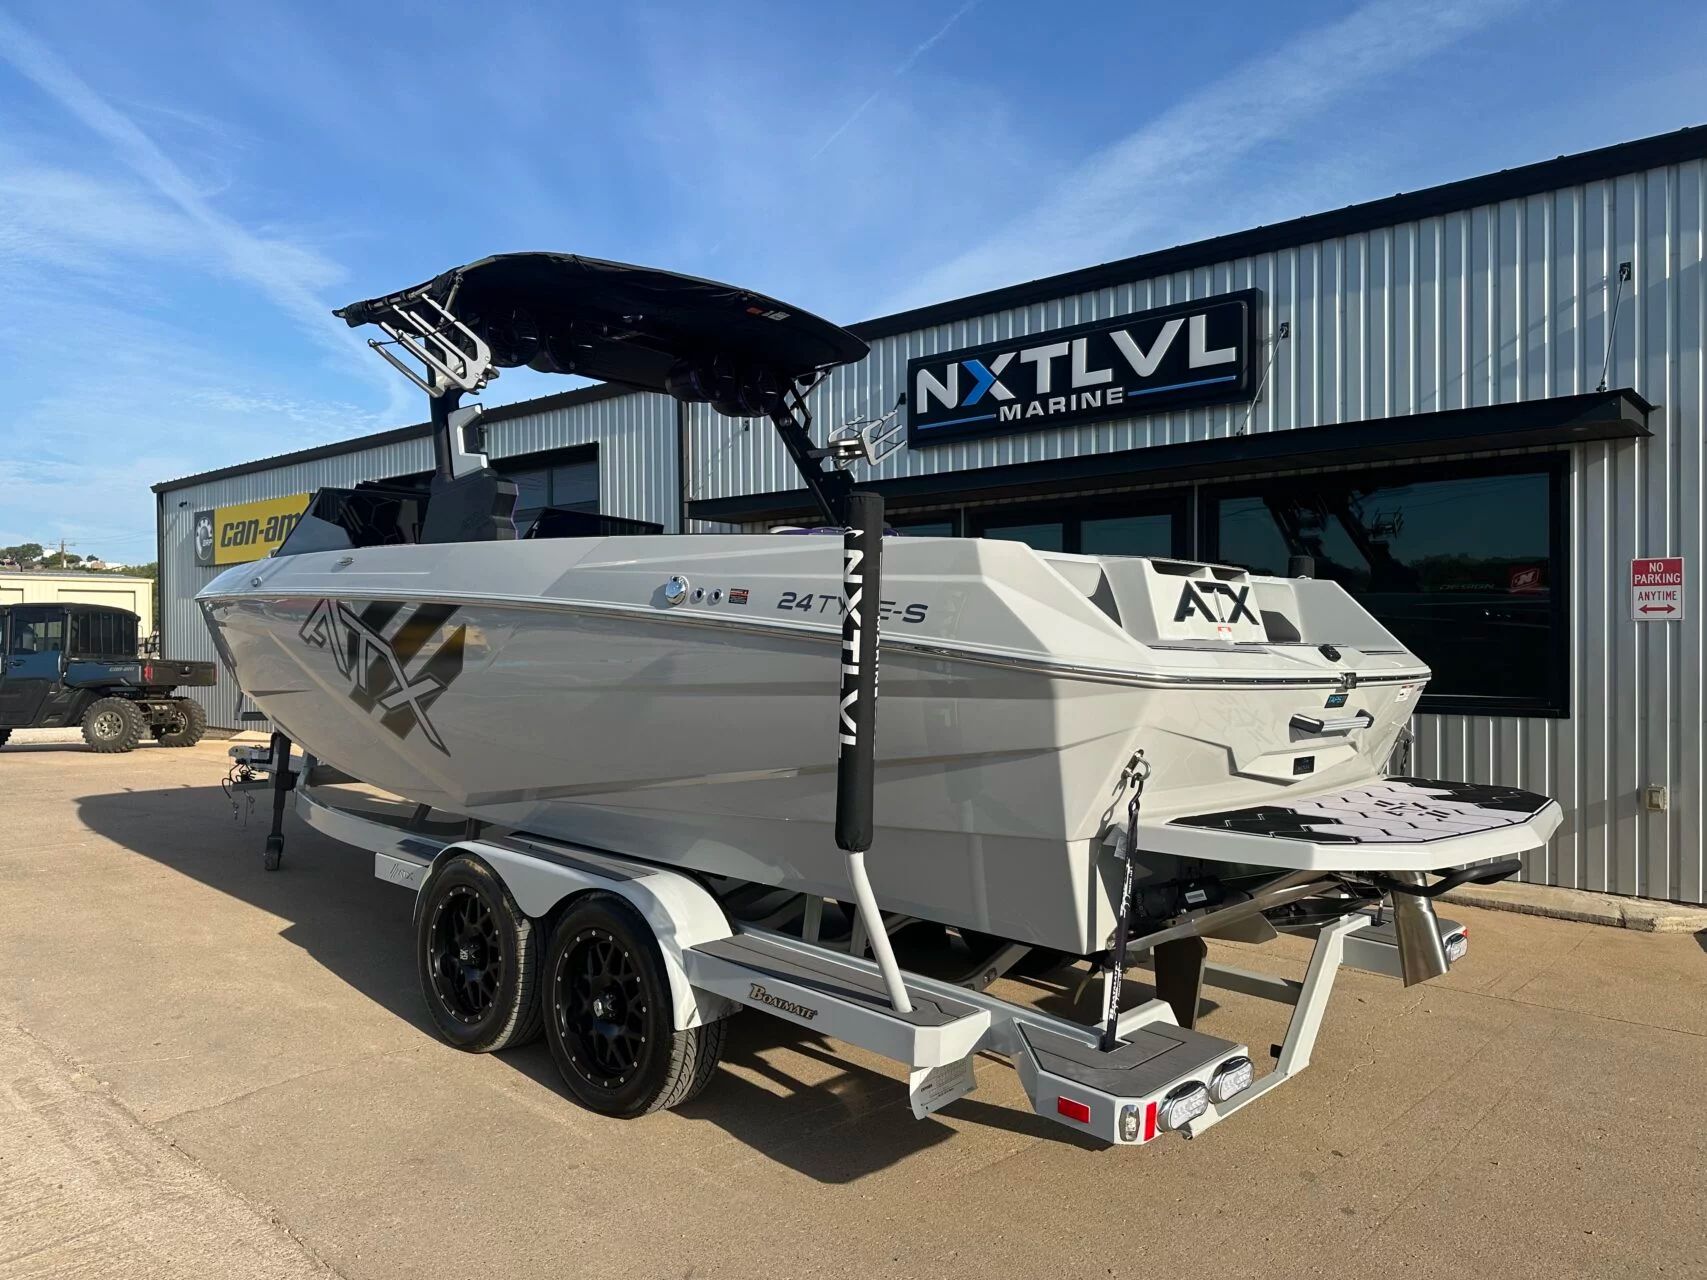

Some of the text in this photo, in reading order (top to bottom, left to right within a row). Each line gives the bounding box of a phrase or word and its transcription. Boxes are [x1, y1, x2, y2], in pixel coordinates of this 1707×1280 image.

[916, 314, 1237, 415] NXTLVL
[1000, 386, 1124, 422] MARINE
[220, 511, 302, 548] can-am
[1634, 573, 1681, 585] PARKING
[1649, 562, 1664, 573] NO
[776, 591, 929, 624] 24TYE-S
[1173, 579, 1261, 626] ATX
[1637, 590, 1677, 601] ANYTIME
